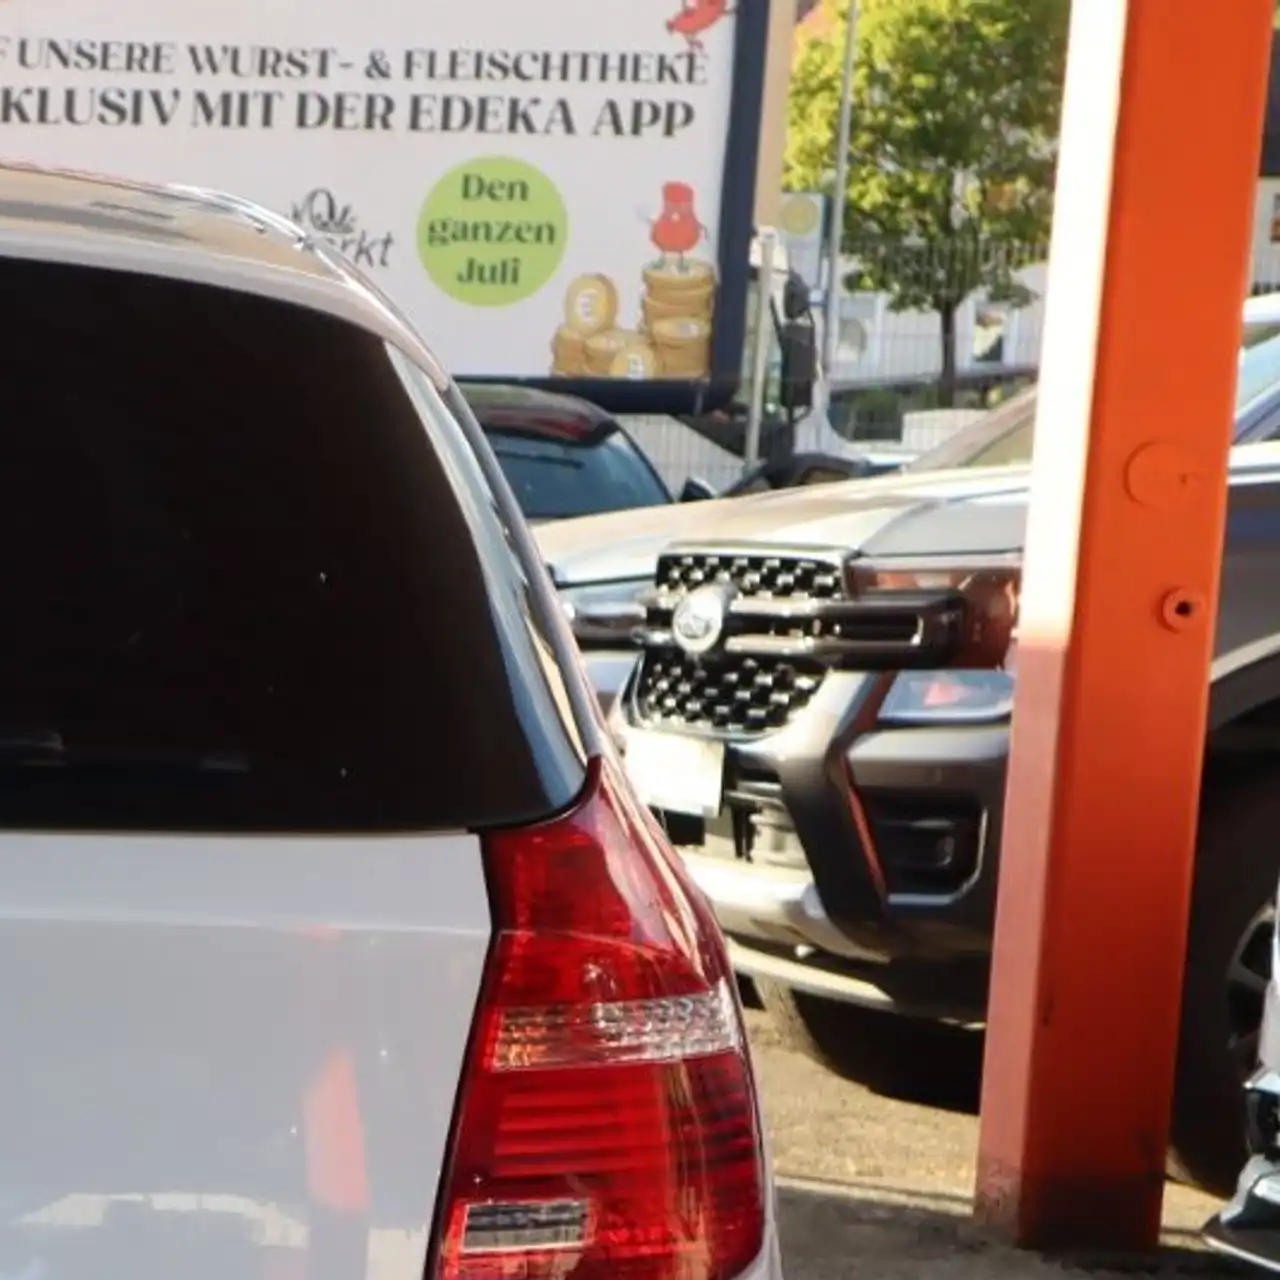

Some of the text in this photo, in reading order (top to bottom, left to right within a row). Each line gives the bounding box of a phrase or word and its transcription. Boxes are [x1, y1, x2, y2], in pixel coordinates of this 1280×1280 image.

[18, 37, 175, 74] UNSERE
[188, 43, 353, 79] WURST-
[364, 48, 392, 81] &
[404, 47, 708, 86] FLEISCHTHEKE
[190, 89, 283, 129] MIT
[295, 91, 395, 132] DER
[407, 93, 576, 135] EDEKA
[593, 99, 695, 138] APP
[461, 173, 530, 202] Den
[427, 218, 556, 247] ganzen
[457, 256, 521, 285] Juli
